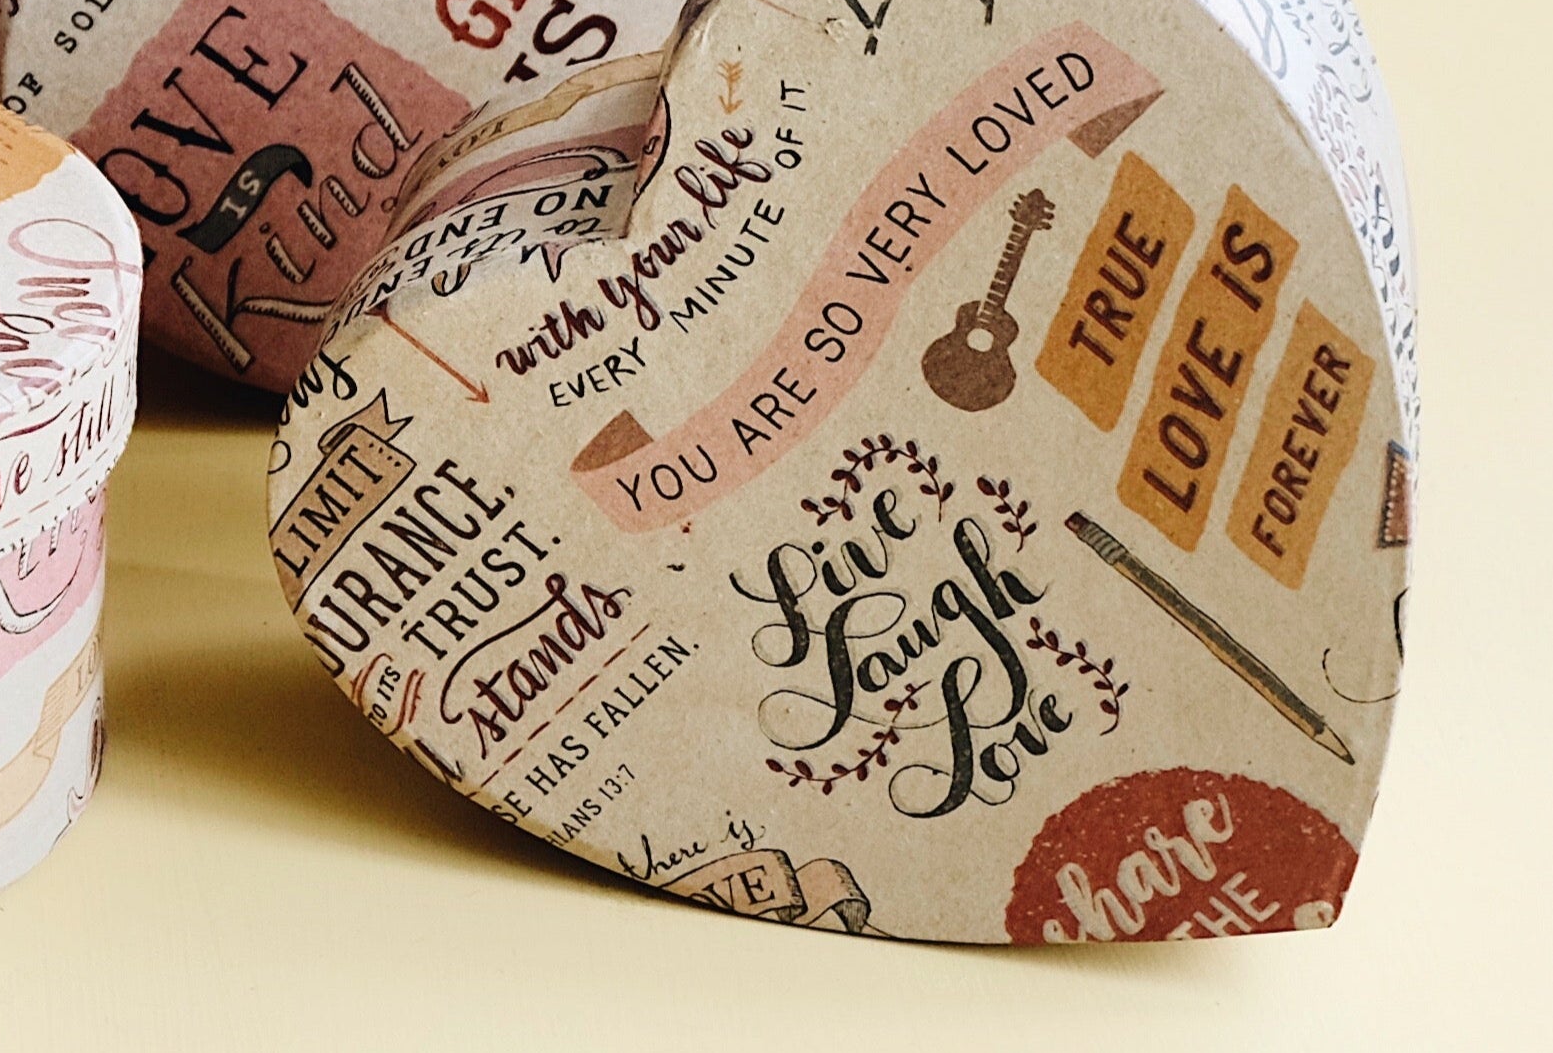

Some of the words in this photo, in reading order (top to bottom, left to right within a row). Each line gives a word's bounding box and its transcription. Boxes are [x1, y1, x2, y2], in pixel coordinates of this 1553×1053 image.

[99, 4, 309, 273] OVE
[774, 126, 806, 170] OF
[780, 79, 807, 113] IT
[170, 60, 423, 377] Kind
[219, 168, 262, 222] IS
[495, 301, 605, 377] with
[597, 217, 704, 332] your
[674, 126, 773, 229] life
[533, 184, 616, 217] NO
[616, 444, 719, 513] YOU
[731, 367, 818, 456] ARE
[803, 300, 864, 363] SO
[845, 172, 947, 285] VERY
[946, 51, 1095, 176] LOVED
[668, 198, 785, 334] MINUTE
[1067, 211, 1167, 367] TRUE
[42, 373, 116, 483] still
[549, 335, 647, 408] EVERY
[1143, 316, 1245, 514] LOVE
[273, 443, 384, 579] LIMIT
[1251, 342, 1353, 558] FOREVER
[402, 521, 562, 662] TRUST.
[728, 488, 918, 668] Live
[757, 517, 1050, 752] Laugh
[378, 665, 402, 704] ITS
[453, 573, 632, 762] stands
[524, 734, 591, 798] HAS
[582, 635, 702, 740] FALLEN.
[598, 763, 637, 804] 13:7
[888, 656, 1074, 819] Love
[617, 834, 709, 882] there
[714, 810, 767, 851] is
[690, 863, 776, 916] VE
[1168, 871, 1282, 943] THE
